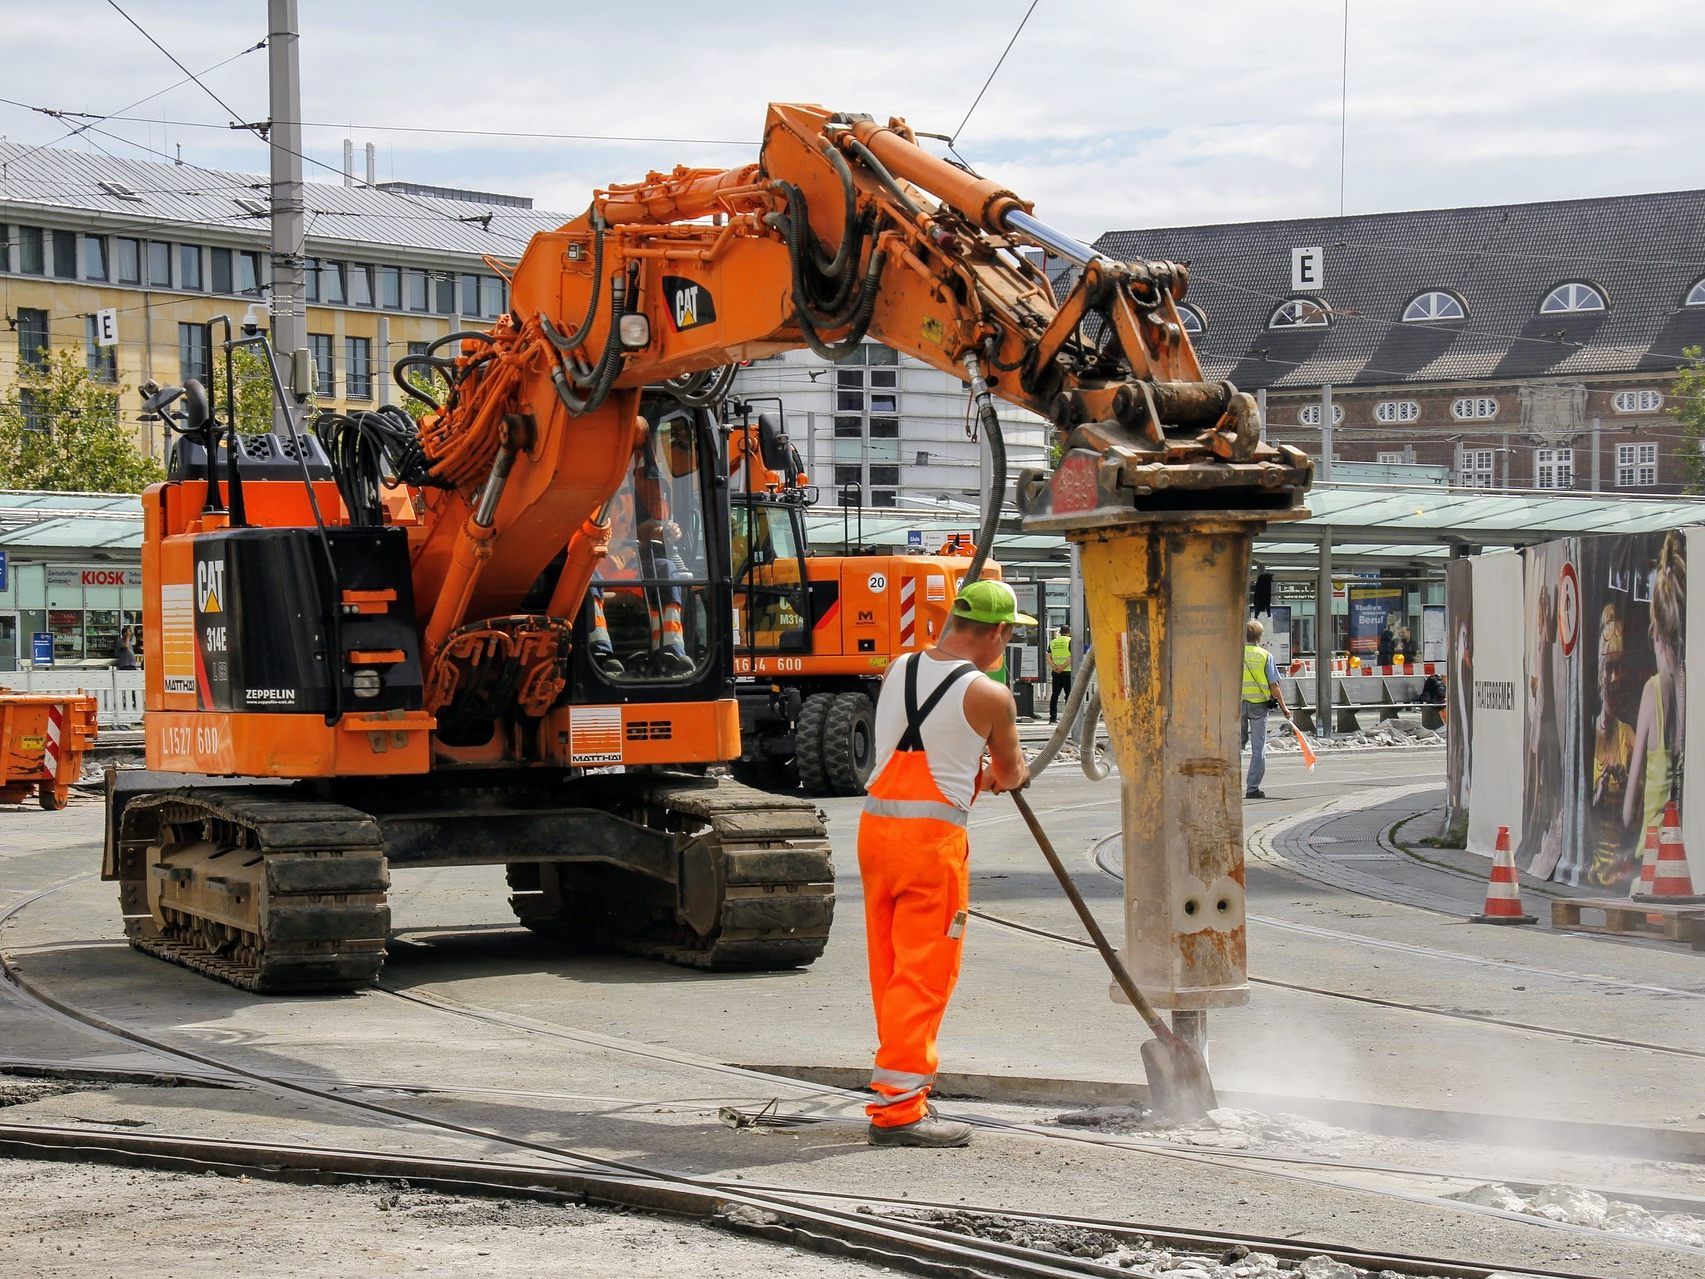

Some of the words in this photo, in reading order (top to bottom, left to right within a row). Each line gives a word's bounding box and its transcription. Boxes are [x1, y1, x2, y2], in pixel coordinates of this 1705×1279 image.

[1301, 255, 1314, 282] E
[676, 285, 698, 327] CAT
[103, 315, 112, 339] E
[82, 571, 125, 585] KIOSK
[197, 560, 224, 613] CAT
[870, 577, 885, 588] 20
[1359, 616, 1384, 624] Beruf
[206, 627, 227, 651] 314E
[778, 658, 802, 671] 600
[246, 689, 295, 699] ZEPPELIN
[197, 727, 218, 755] 600
